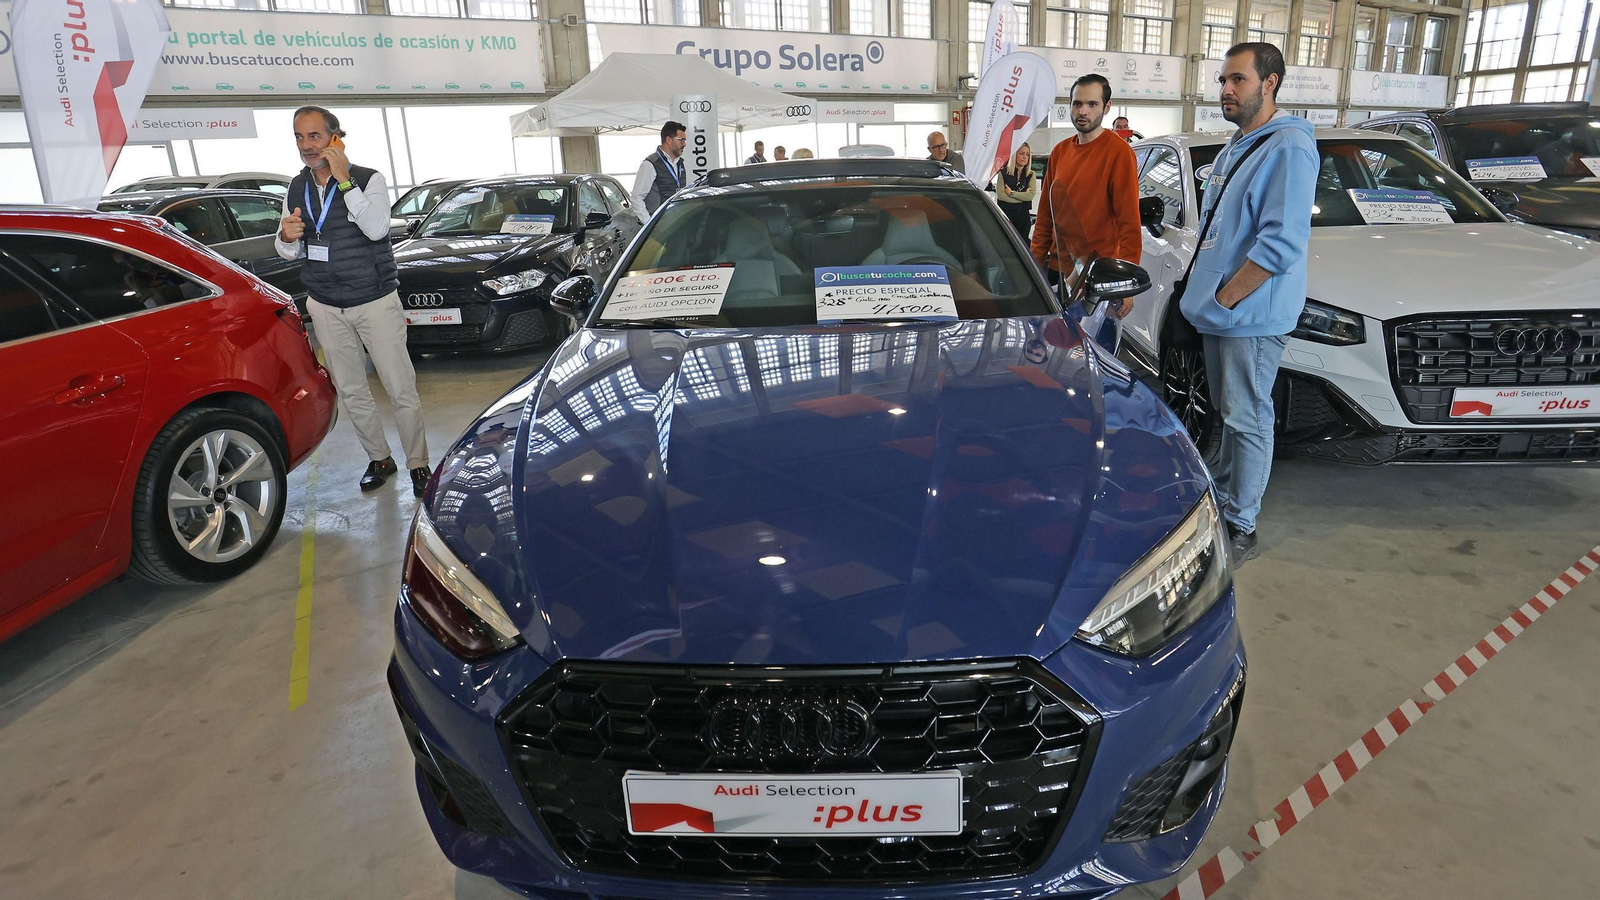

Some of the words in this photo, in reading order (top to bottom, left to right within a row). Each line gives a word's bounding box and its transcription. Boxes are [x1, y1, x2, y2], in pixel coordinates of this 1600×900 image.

[64, 0, 95, 62] :plu
[168, 32, 179, 44] u
[187, 29, 247, 48] portal
[254, 29, 276, 46] de
[282, 30, 367, 48] vehículos
[374, 33, 393, 48] de
[400, 34, 460, 50] ocasión
[463, 38, 474, 52] y
[53, 33, 69, 93] Selection
[161, 51, 354, 67] www.buscatucoche.com
[779, 44, 864, 72] Solera
[1001, 65, 1023, 114] :plus
[60, 97, 75, 127] Audi
[842, 108, 870, 116] Selection
[986, 93, 1001, 129] Selection
[142, 119, 203, 129] Selection
[206, 120, 238, 130] :plus
[982, 130, 992, 148] Audi
[690, 274, 720, 282] dto.
[835, 288, 877, 296] PRECIO
[880, 286, 932, 295] ESPECIAL
[619, 304, 638, 312] con
[640, 300, 667, 309] AUDI
[671, 297, 716, 307] OPCIÓN
[430, 314, 453, 323] :plus
[1496, 390, 1519, 398] Audi
[1538, 397, 1591, 413] :plus
[713, 784, 760, 796] Audi
[765, 784, 856, 796] Selection
[813, 799, 923, 829] :plus
